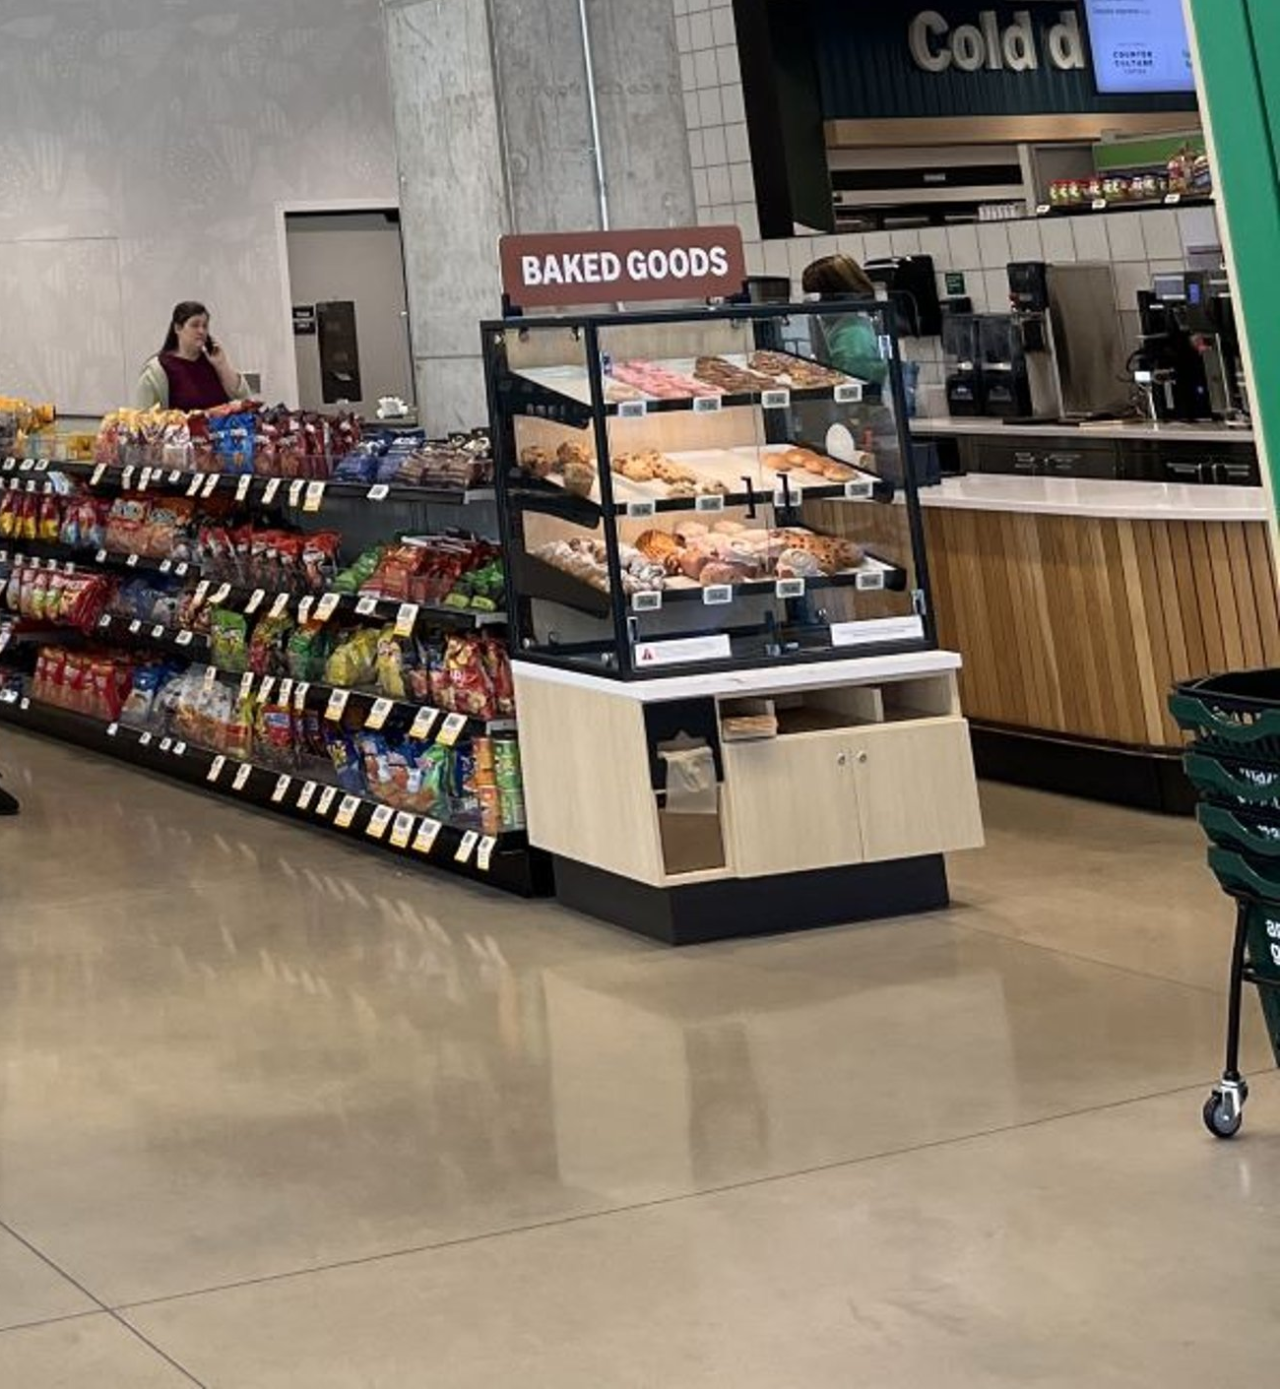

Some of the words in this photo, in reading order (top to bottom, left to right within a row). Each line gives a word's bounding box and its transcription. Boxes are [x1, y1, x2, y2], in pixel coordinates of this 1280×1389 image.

[908, 9, 1038, 72] Cold
[521, 251, 621, 286] BAKED
[626, 245, 729, 282] GOODS
